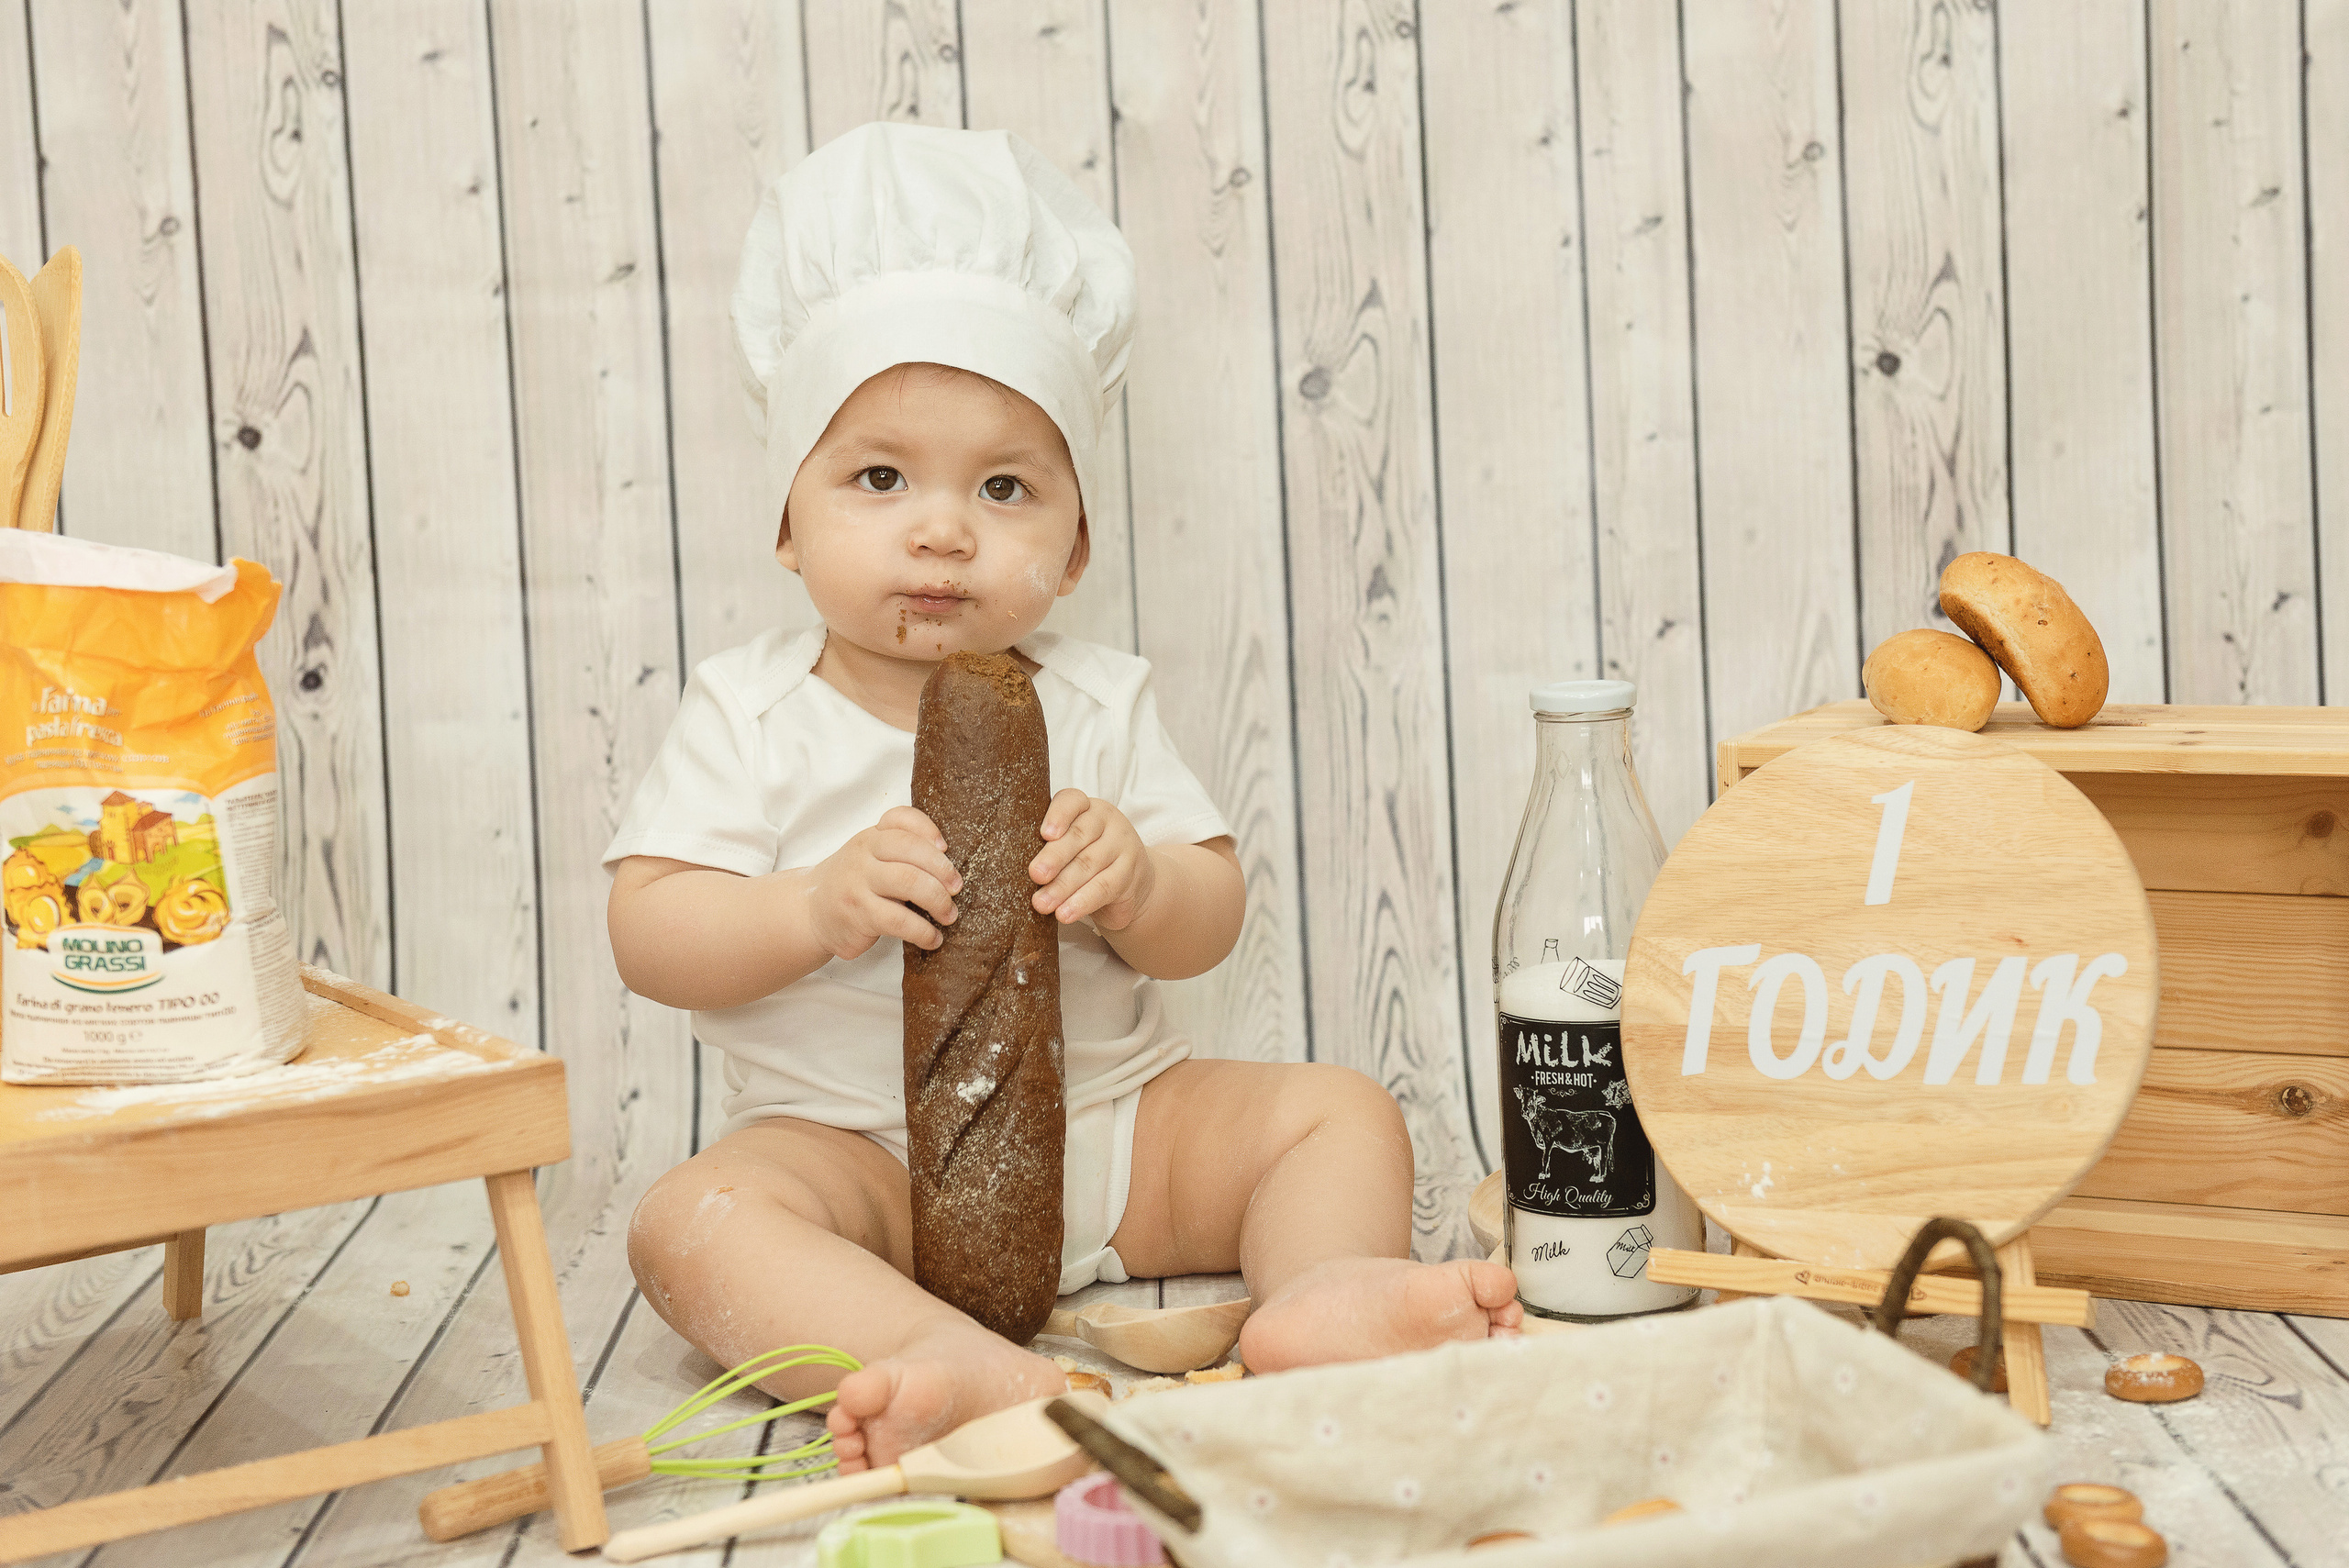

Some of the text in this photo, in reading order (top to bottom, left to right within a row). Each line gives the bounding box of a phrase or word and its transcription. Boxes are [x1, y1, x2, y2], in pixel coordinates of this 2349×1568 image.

[1865, 780, 1915, 906] 1
[65, 954, 146, 972] GRASSI
[1681, 942, 2128, 1085] ГОДИК
[83, 1030, 115, 1042] 1000
[1523, 1183, 1614, 1209] High Quality
[1531, 1240, 1570, 1262] Milk
